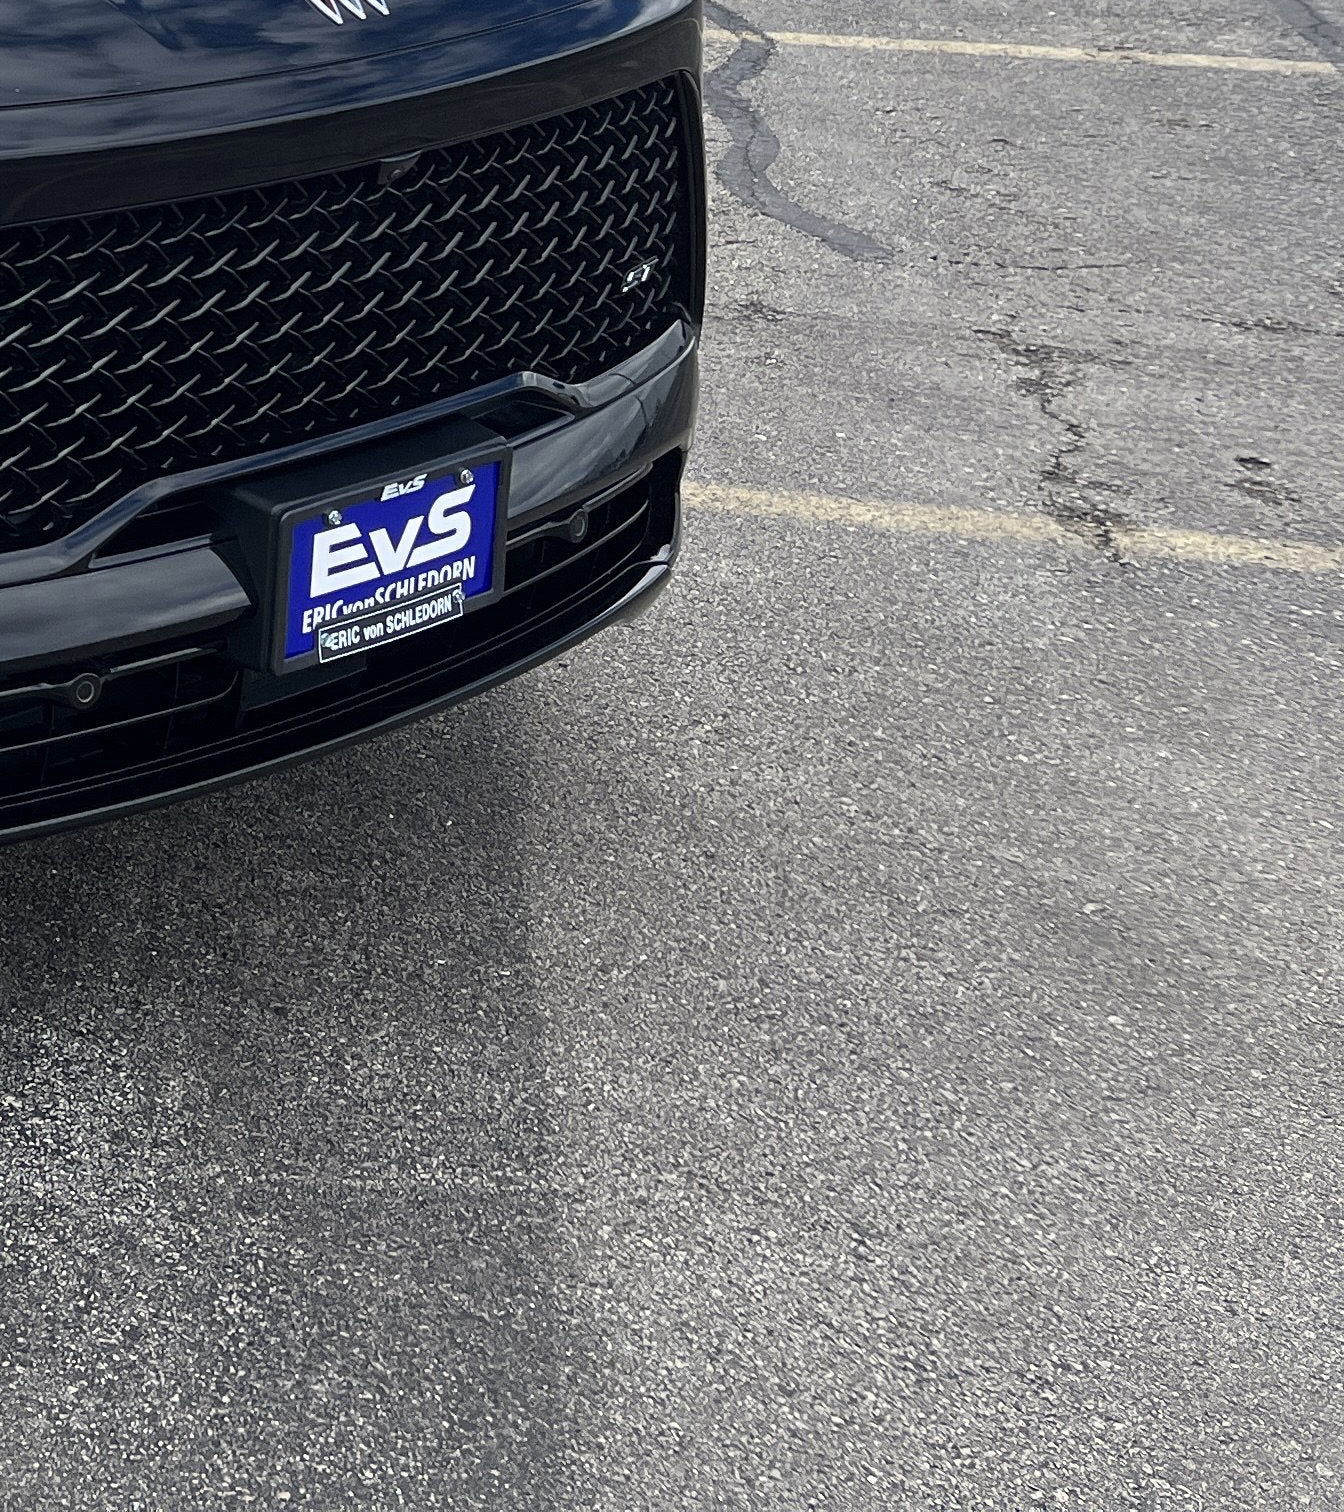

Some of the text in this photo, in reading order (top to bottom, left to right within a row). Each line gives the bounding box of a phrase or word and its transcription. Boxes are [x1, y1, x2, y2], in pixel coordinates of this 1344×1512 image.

[329, 593, 452, 651] ERIC von SCHLEDORN
